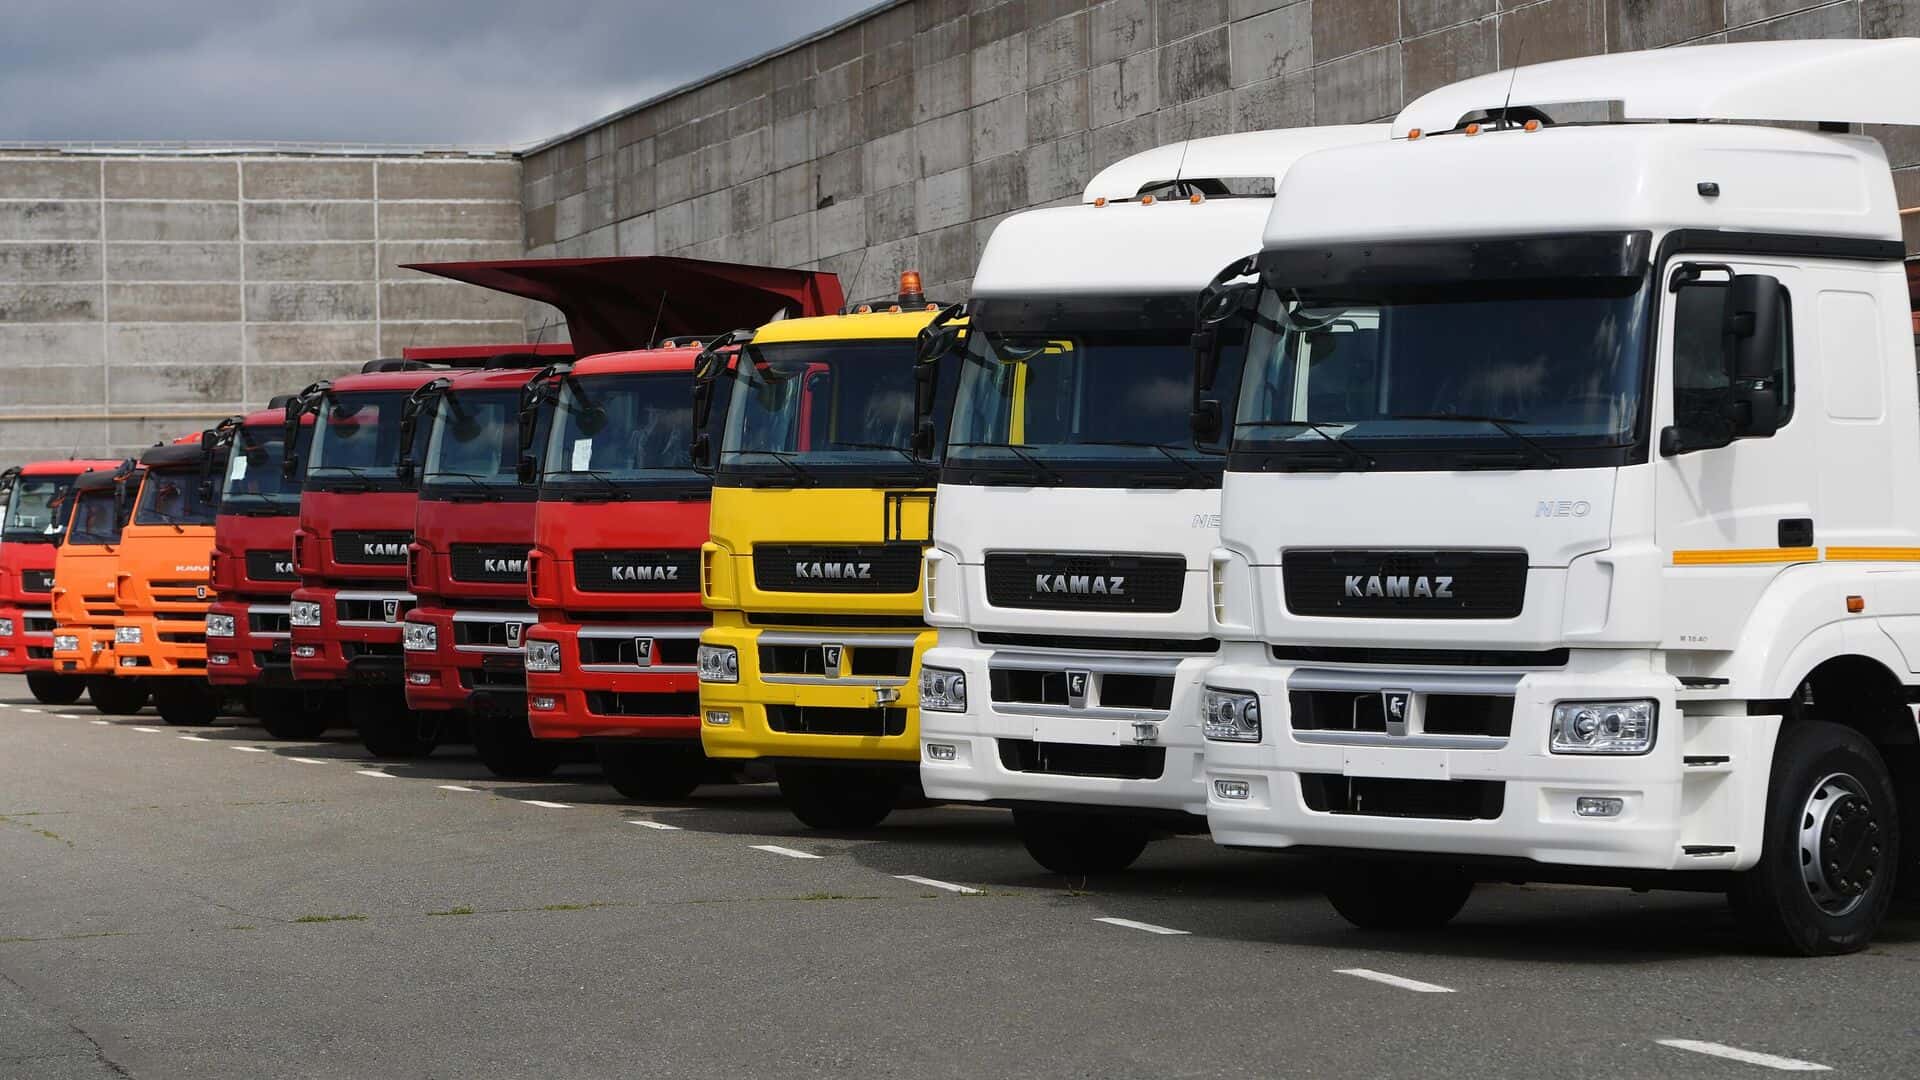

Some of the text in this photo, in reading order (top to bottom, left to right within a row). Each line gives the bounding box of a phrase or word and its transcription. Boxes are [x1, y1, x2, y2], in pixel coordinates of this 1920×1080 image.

[1536, 501, 1592, 517] NEO
[611, 565, 679, 580] KAMAZ
[795, 562, 872, 579] KAMAZ
[1036, 574, 1125, 595] KAMAZ
[1344, 575, 1453, 598] KAMAZ
